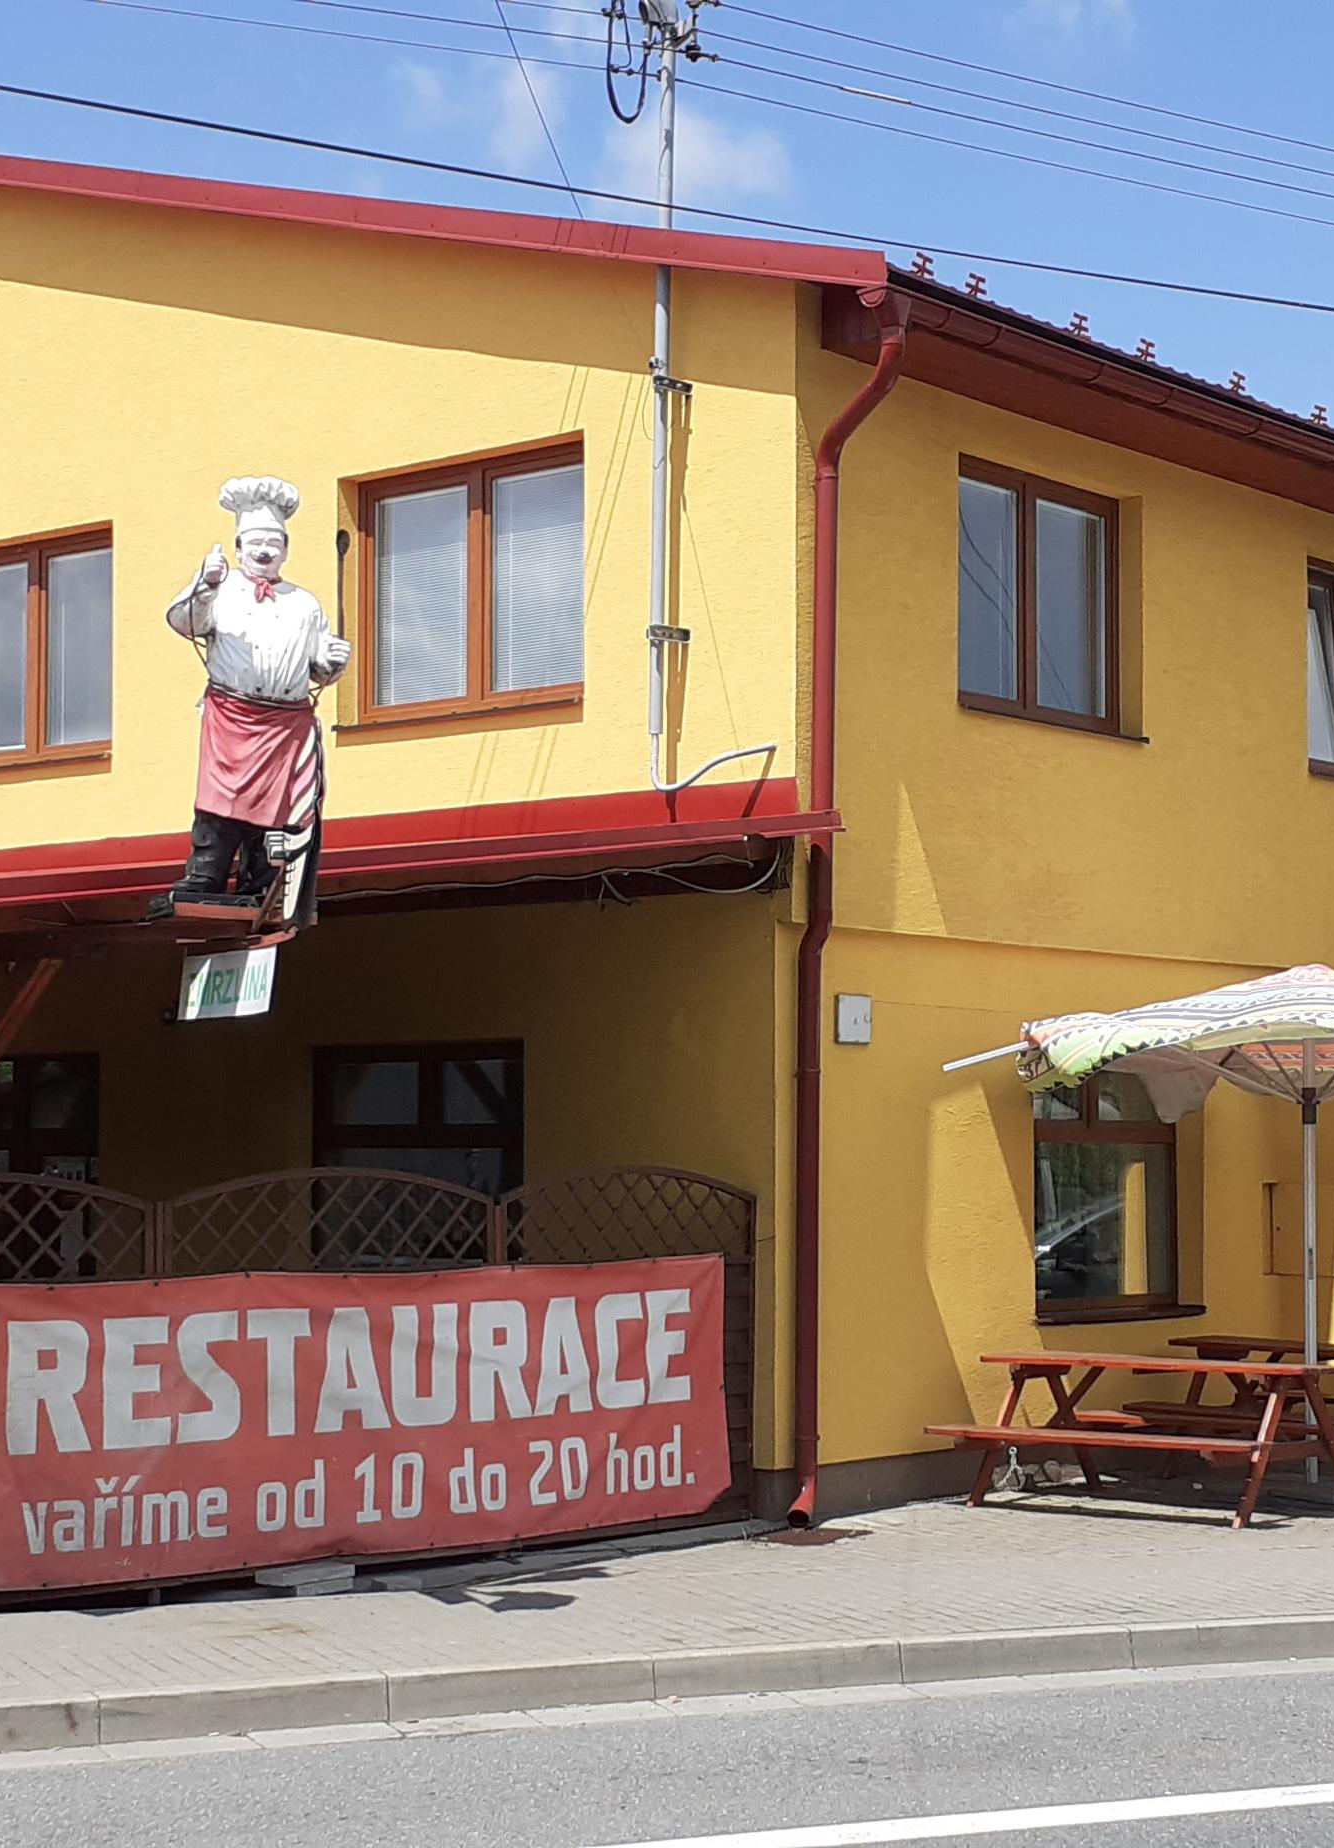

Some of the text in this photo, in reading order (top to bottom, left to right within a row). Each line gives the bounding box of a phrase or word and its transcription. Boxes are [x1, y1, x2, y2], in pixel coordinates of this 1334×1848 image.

[188, 964, 268, 1007] ZMRZLINA
[5, 1287, 693, 1456] RESTAURACE
[21, 1424, 696, 1555] vaříme od 10 do 20 hod.
